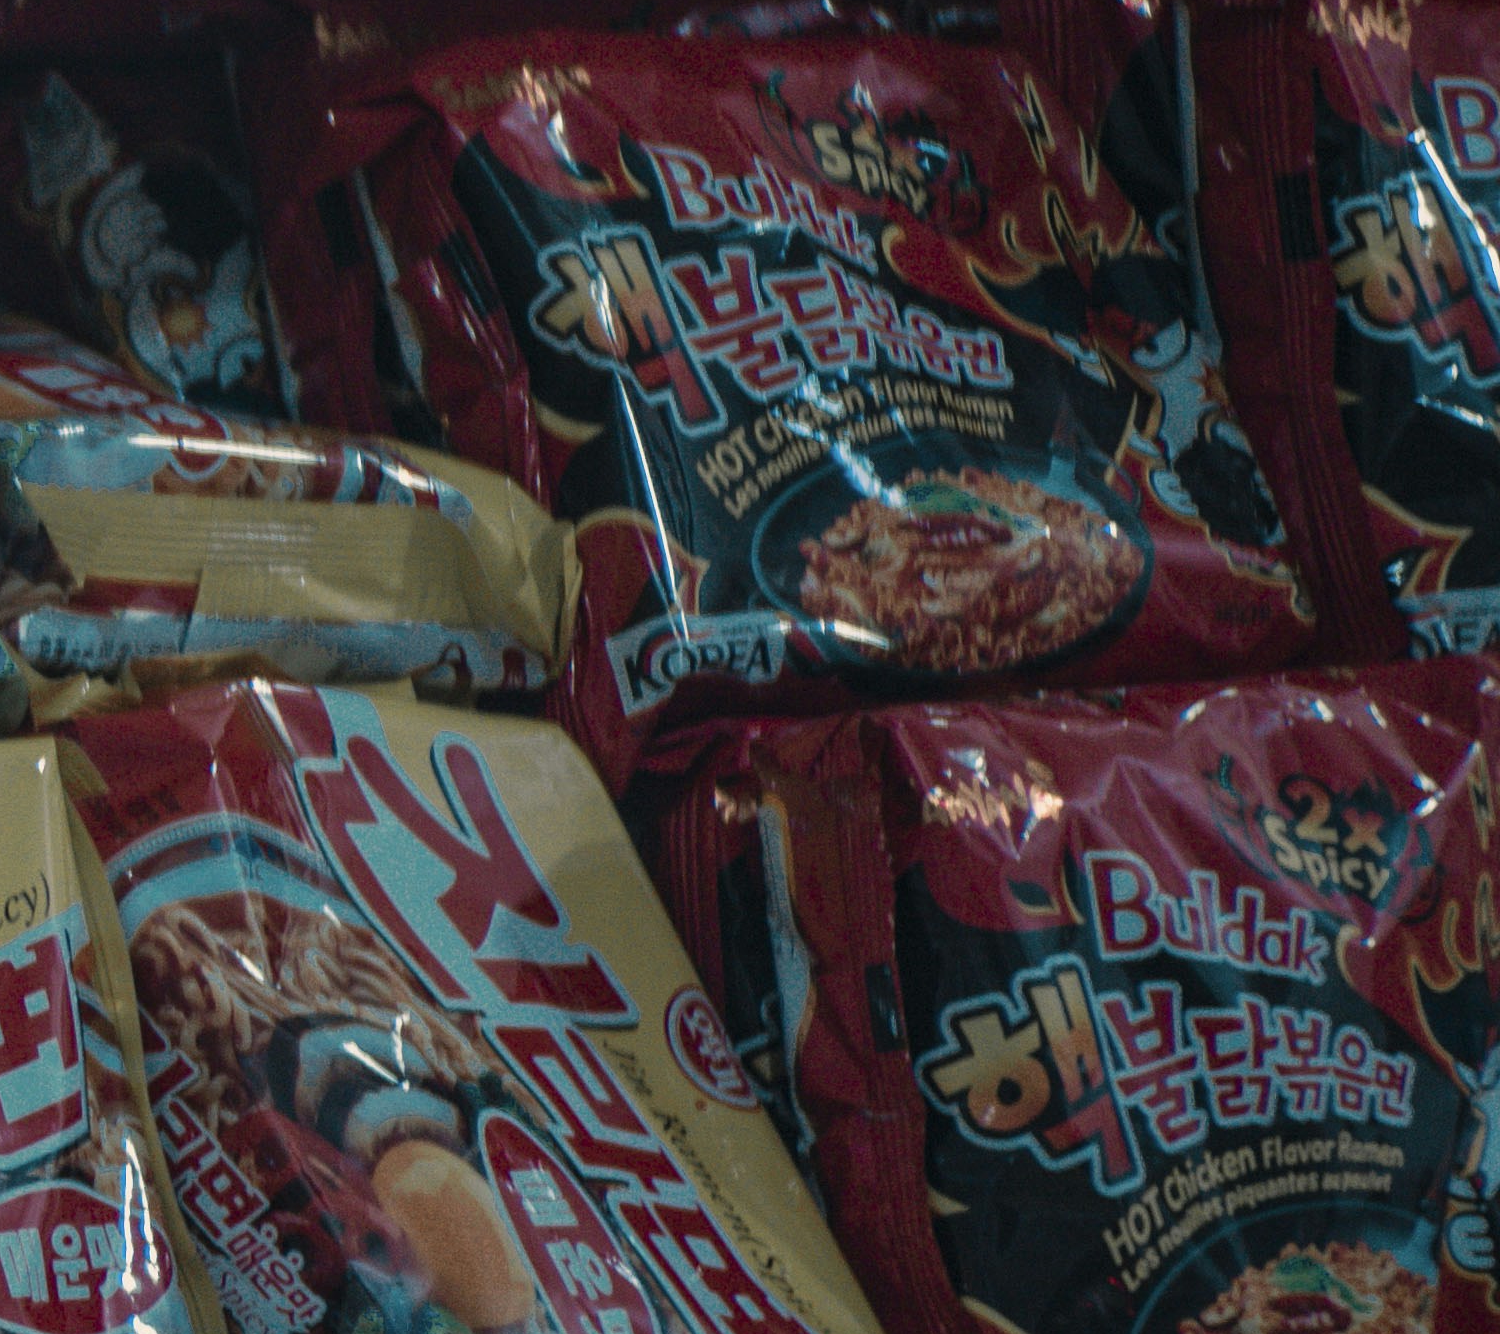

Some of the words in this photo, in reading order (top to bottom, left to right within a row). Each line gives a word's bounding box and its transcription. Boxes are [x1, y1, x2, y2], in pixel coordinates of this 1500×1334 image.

[811, 121, 927, 217] Spicy
[695, 424, 753, 499] HOT
[1264, 816, 1393, 902] Spicy
[1085, 849, 1328, 986] Buldak
[1102, 1184, 1167, 1267] HOT
[1162, 1146, 1257, 1213] Chicken
[1260, 1134, 1336, 1166] Flavor
[1337, 1129, 1405, 1168] Ramen
[225, 1221, 330, 1334] 매운맛
[1121, 1249, 1158, 1294] Les
